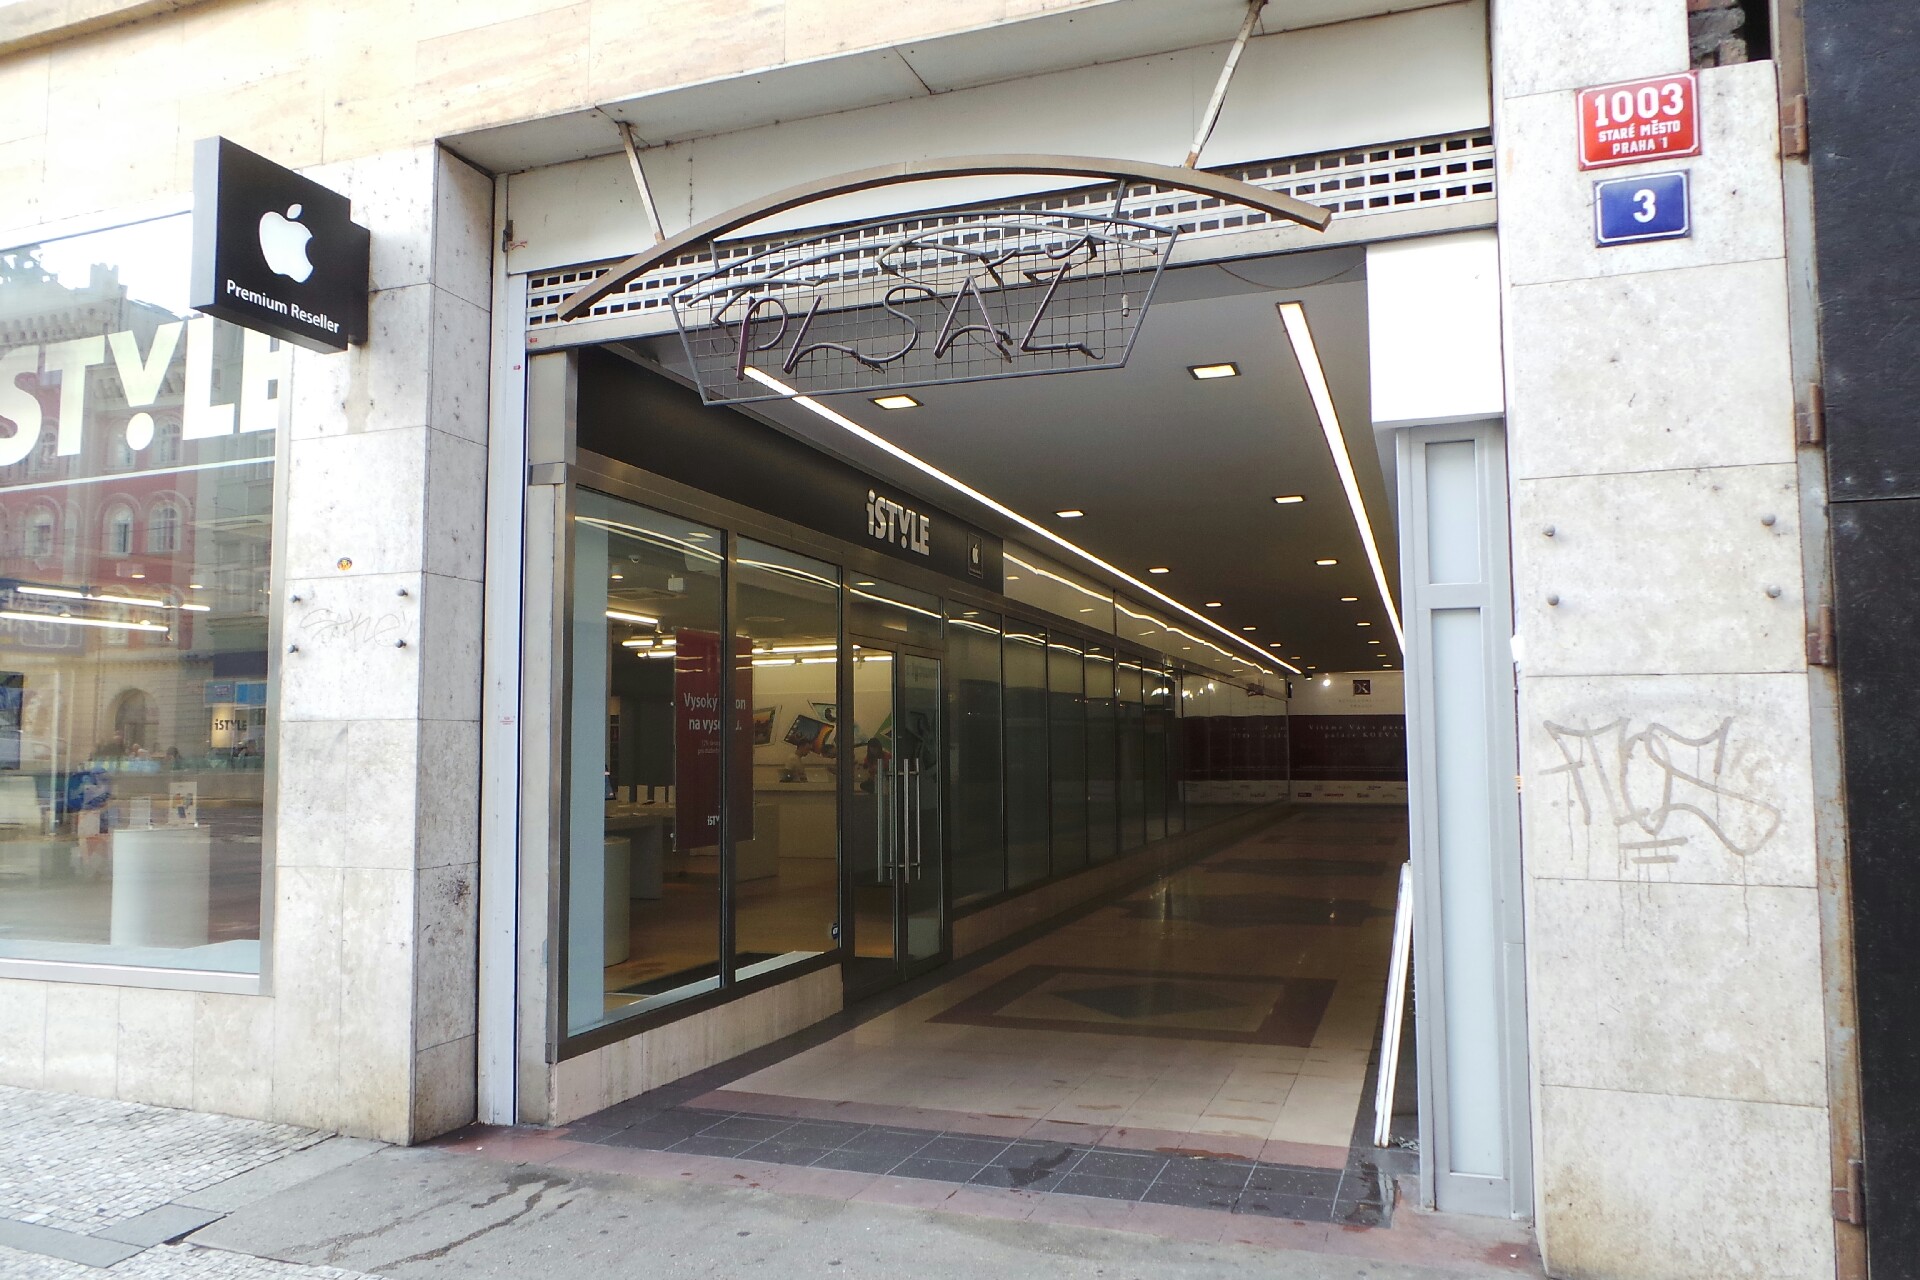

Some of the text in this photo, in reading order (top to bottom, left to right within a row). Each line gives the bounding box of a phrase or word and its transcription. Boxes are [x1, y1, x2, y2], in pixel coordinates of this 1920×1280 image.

[1595, 83, 1684, 127] 1003
[1598, 119, 1681, 143] STARÉ MĚSTO
[1612, 137, 1669, 156] PRAHA 1
[1632, 189, 1657, 224] 3
[226, 279, 340, 335] Premium Reseller
[865, 489, 931, 556] iSTYLE
[683, 692, 718, 712] Vysoký
[688, 718, 701, 731] na
